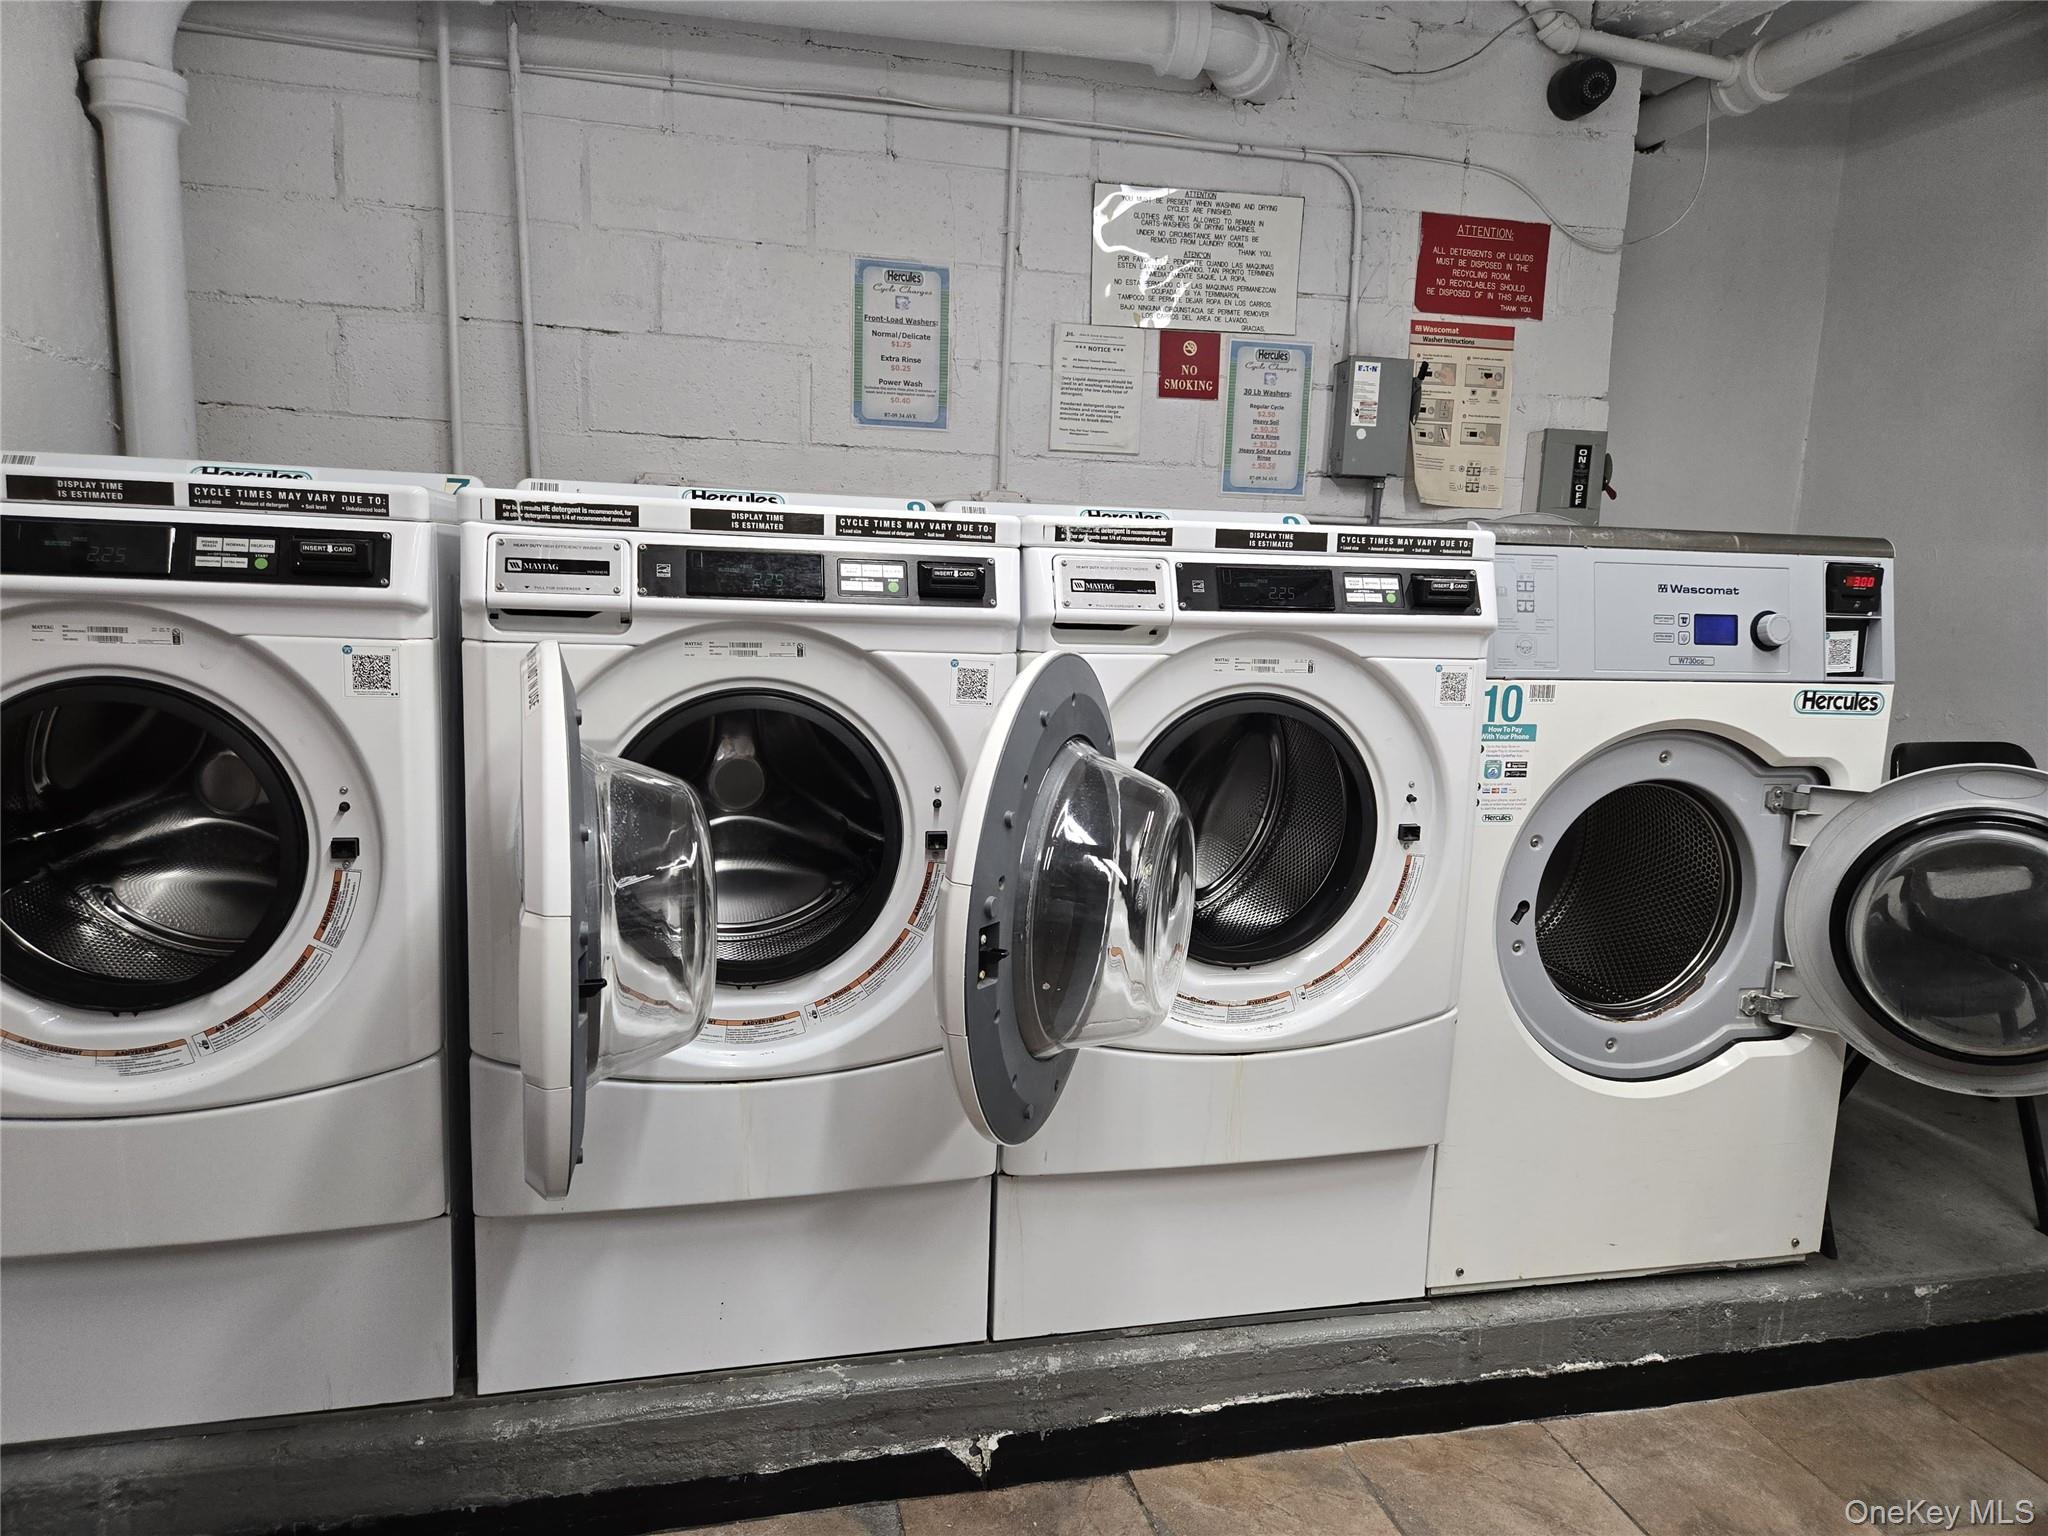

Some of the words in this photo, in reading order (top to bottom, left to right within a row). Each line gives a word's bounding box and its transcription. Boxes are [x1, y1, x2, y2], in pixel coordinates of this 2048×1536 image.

[1185, 190, 1217, 199] ATTENTION
[1166, 198, 1192, 206] PRESENT
[1215, 201, 1240, 209] WASHING
[1193, 216, 1221, 224] ALLOWED
[1234, 218, 1256, 226] REMAIN
[1204, 223, 1224, 231] DRYING
[1457, 224, 1514, 240] ATTENTION:
[1169, 231, 1210, 240] CIRCUMSTANCE
[1432, 246, 1446, 255] ALL
[1450, 248, 1492, 259] DETERGENTS
[1496, 251, 1506, 260] OR
[1509, 252, 1534, 262] LIQUIDS
[1435, 257, 1454, 267] MUST
[1458, 259, 1467, 267] BE
[1471, 260, 1502, 270] DISPOSED
[1505, 263, 1513, 271] IN
[1517, 263, 1529, 272] THE
[887, 270, 921, 284] Hercules
[1452, 269, 1488, 279] RECYCLING
[872, 283, 896, 294] Cycle
[899, 285, 933, 297] Charges
[1236, 285, 1277, 293] PERMANEZCAN
[1436, 278, 1446, 286] NO
[1450, 279, 1496, 290] RECYCLABLES
[1499, 282, 1526, 293] SHOULD
[1117, 293, 1145, 301] TAMPOCO
[1426, 287, 1436, 296] BE
[1438, 288, 1471, 298] DISPOSED
[1474, 290, 1484, 299] OF
[1487, 291, 1494, 300] IN
[1498, 292, 1512, 301] THIS
[1515, 294, 1533, 303] AREA
[1499, 304, 1518, 312] THANK
[1243, 310, 1269, 318] REMOVER
[864, 313, 903, 325] Front-Load
[905, 316, 939, 328] Washers:
[1422, 324, 1459, 335] Wascomat
[871, 329, 931, 341] Normal/Delicate
[1422, 335, 1441, 344] Washer
[1443, 336, 1475, 346] Instructions
[1088, 345, 1111, 353] NOTICE
[880, 354, 900, 364] Extra
[901, 355, 922, 365] Rinse
[1258, 349, 1288, 361] Hercules
[1181, 364, 1198, 376] NO
[1245, 362, 1266, 371] Cycle
[1268, 363, 1297, 372] Charges
[878, 378, 901, 387] Power
[902, 379, 923, 388] Wash
[1164, 378, 1213, 392] SMOKING
[1243, 388, 1252, 396] 30
[1253, 389, 1262, 397] Lb
[1263, 389, 1292, 398] Washers:
[1250, 403, 1270, 411] Regular
[1270, 404, 1285, 412] Cycle
[1578, 448, 1588, 464] ON
[57, 480, 97, 489] DISPLAY
[100, 481, 124, 490] TIME
[71, 490, 124, 500] ESTIMATED
[194, 487, 231, 497] CYCLE
[237, 489, 272, 499] TIMES
[278, 491, 302, 501] MAY
[307, 493, 336, 503] VARY
[341, 495, 363, 504] DUE
[368, 496, 387, 506] TO:
[1574, 484, 1584, 506] OFF
[551, 505, 581, 514] detergent
[731, 512, 763, 521] DISPLAY
[765, 514, 784, 522] TIME
[741, 521, 784, 530] ESTIMATED
[840, 518, 870, 527] CYCLE
[873, 519, 902, 529] TIMES
[906, 521, 925, 530] MAY
[929, 522, 953, 531] VARY
[956, 523, 974, 532] DUE
[977, 524, 993, 533] TO:
[1249, 531, 1276, 540] DISPLAY
[1257, 540, 1294, 548] ESTIMATED
[1341, 535, 1366, 544] CYCLE
[1369, 537, 1394, 545] TIMES
[1397, 538, 1414, 546] MAY
[1417, 538, 1437, 547] VARY
[1440, 540, 1456, 548] DUE
[1459, 540, 1472, 549] TO:
[302, 544, 326, 552] INSERT
[333, 545, 353, 553] CARD
[523, 563, 559, 571] MAYTAG
[1085, 582, 1115, 590] MAYTAG
[1670, 584, 1740, 596] Wascomat
[1677, 657, 1705, 666] W730cc
[1485, 685, 1523, 722] 10
[1801, 690, 1879, 712] Hercules
[1511, 726, 1523, 734] Pay
[1484, 813, 1511, 822] Hercules
